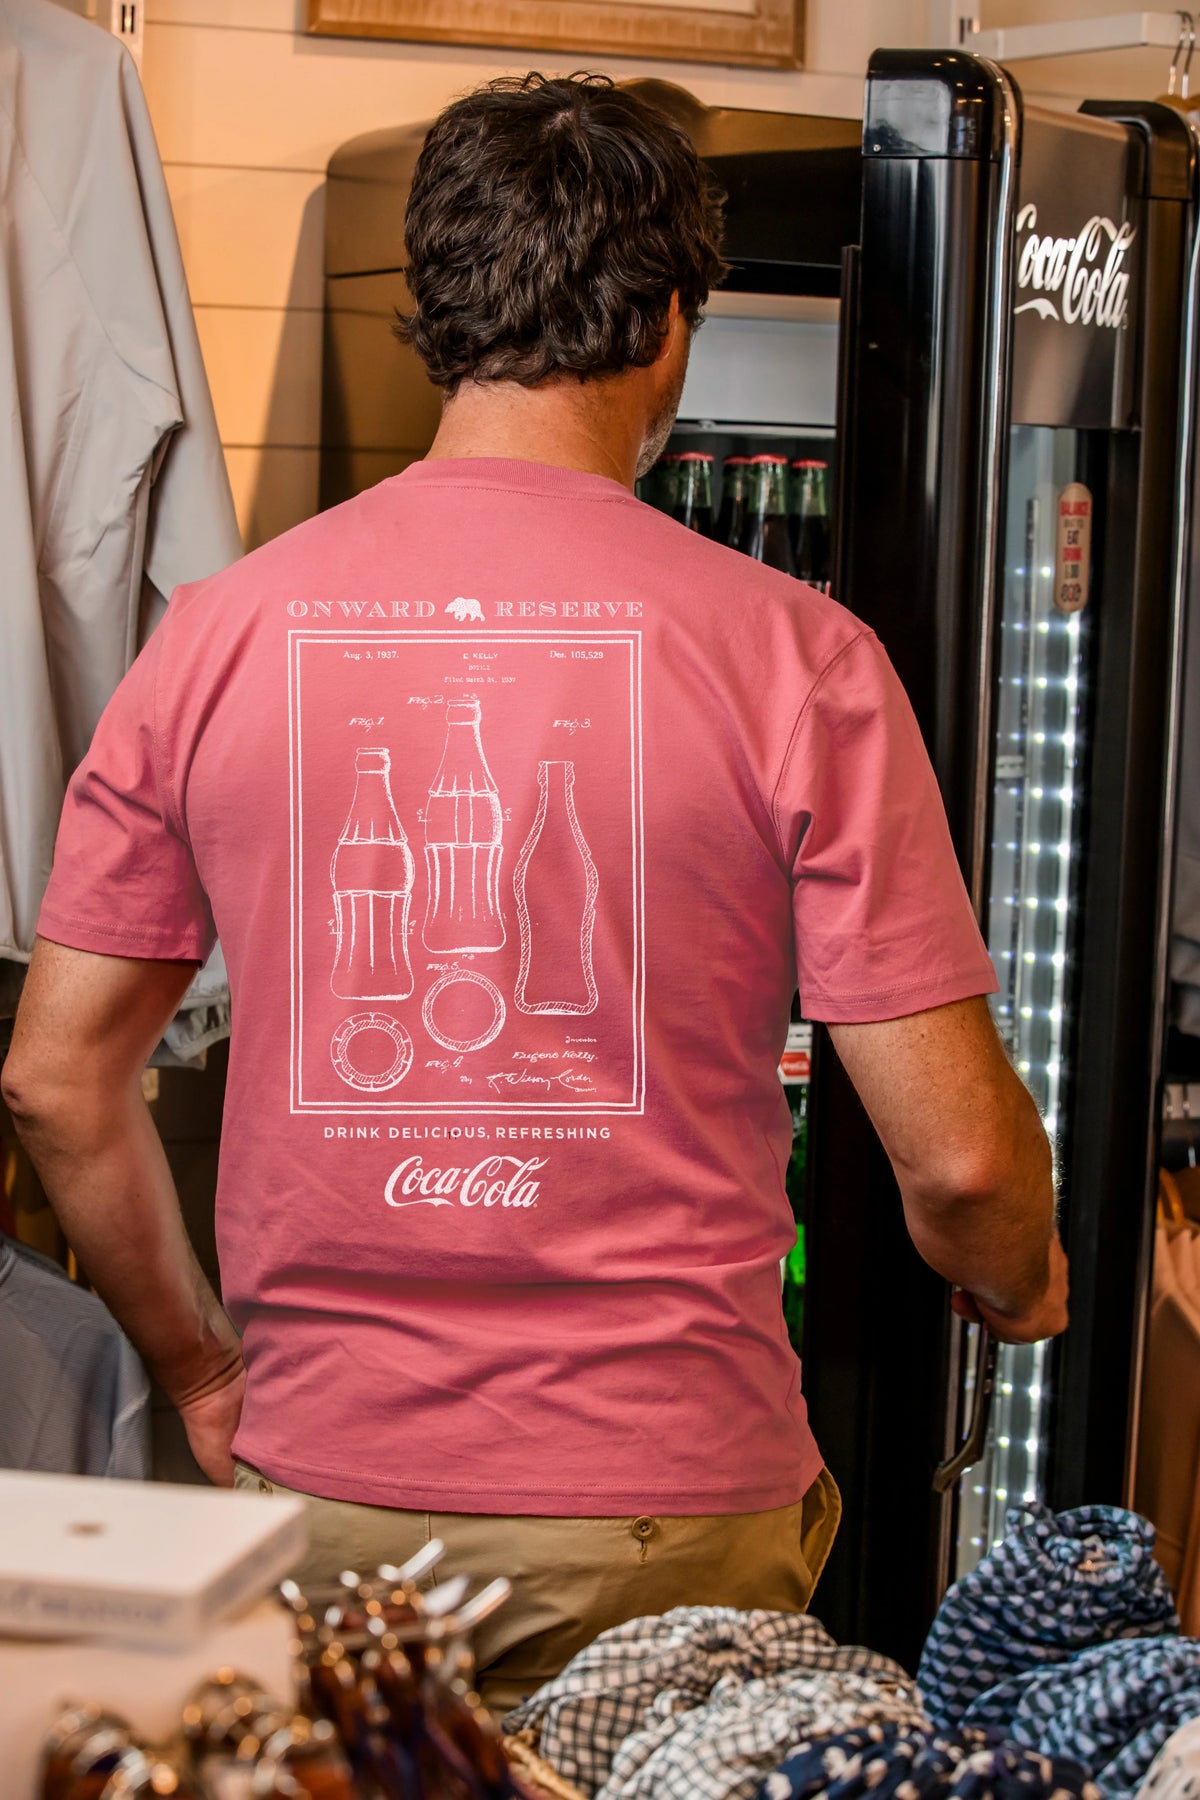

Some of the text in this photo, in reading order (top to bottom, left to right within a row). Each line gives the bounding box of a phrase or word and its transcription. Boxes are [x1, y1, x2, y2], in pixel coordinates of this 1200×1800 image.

[286, 599, 644, 618] ONWARD RESERVE
[571, 650, 604, 660] 105,529
[512, 1051, 559, 1063] Eugene
[324, 1127, 611, 1140] DRINK DELICIOUS, REFRESHING
[384, 1155, 550, 1208] Coca-Cola
